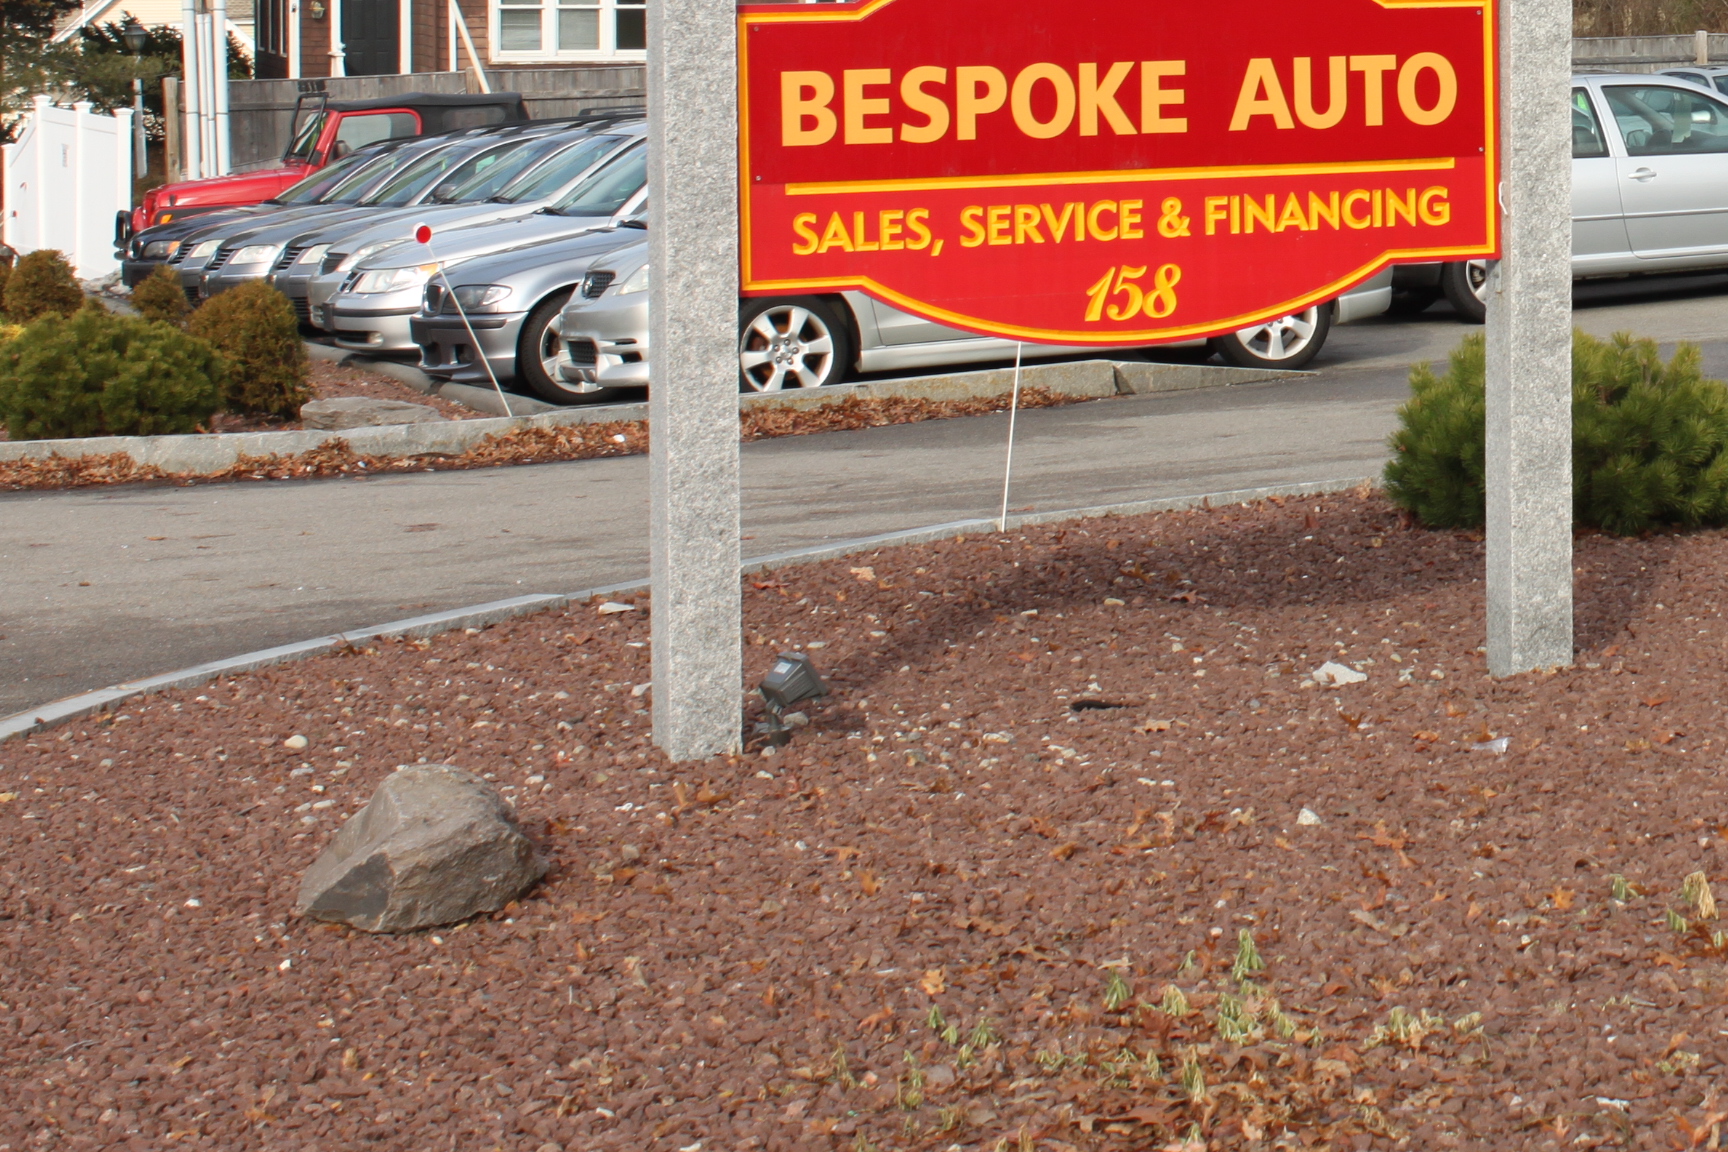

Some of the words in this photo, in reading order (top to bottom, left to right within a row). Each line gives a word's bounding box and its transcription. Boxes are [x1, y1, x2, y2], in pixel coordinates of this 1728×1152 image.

[780, 59, 1188, 147] BESPOKE
[1228, 51, 1458, 131] AUTO
[793, 208, 944, 257] SALES,
[960, 199, 1144, 248] SERVICE
[1157, 197, 1191, 237] &
[1205, 186, 1450, 235] FINANCING
[1084, 263, 1182, 322] 158
